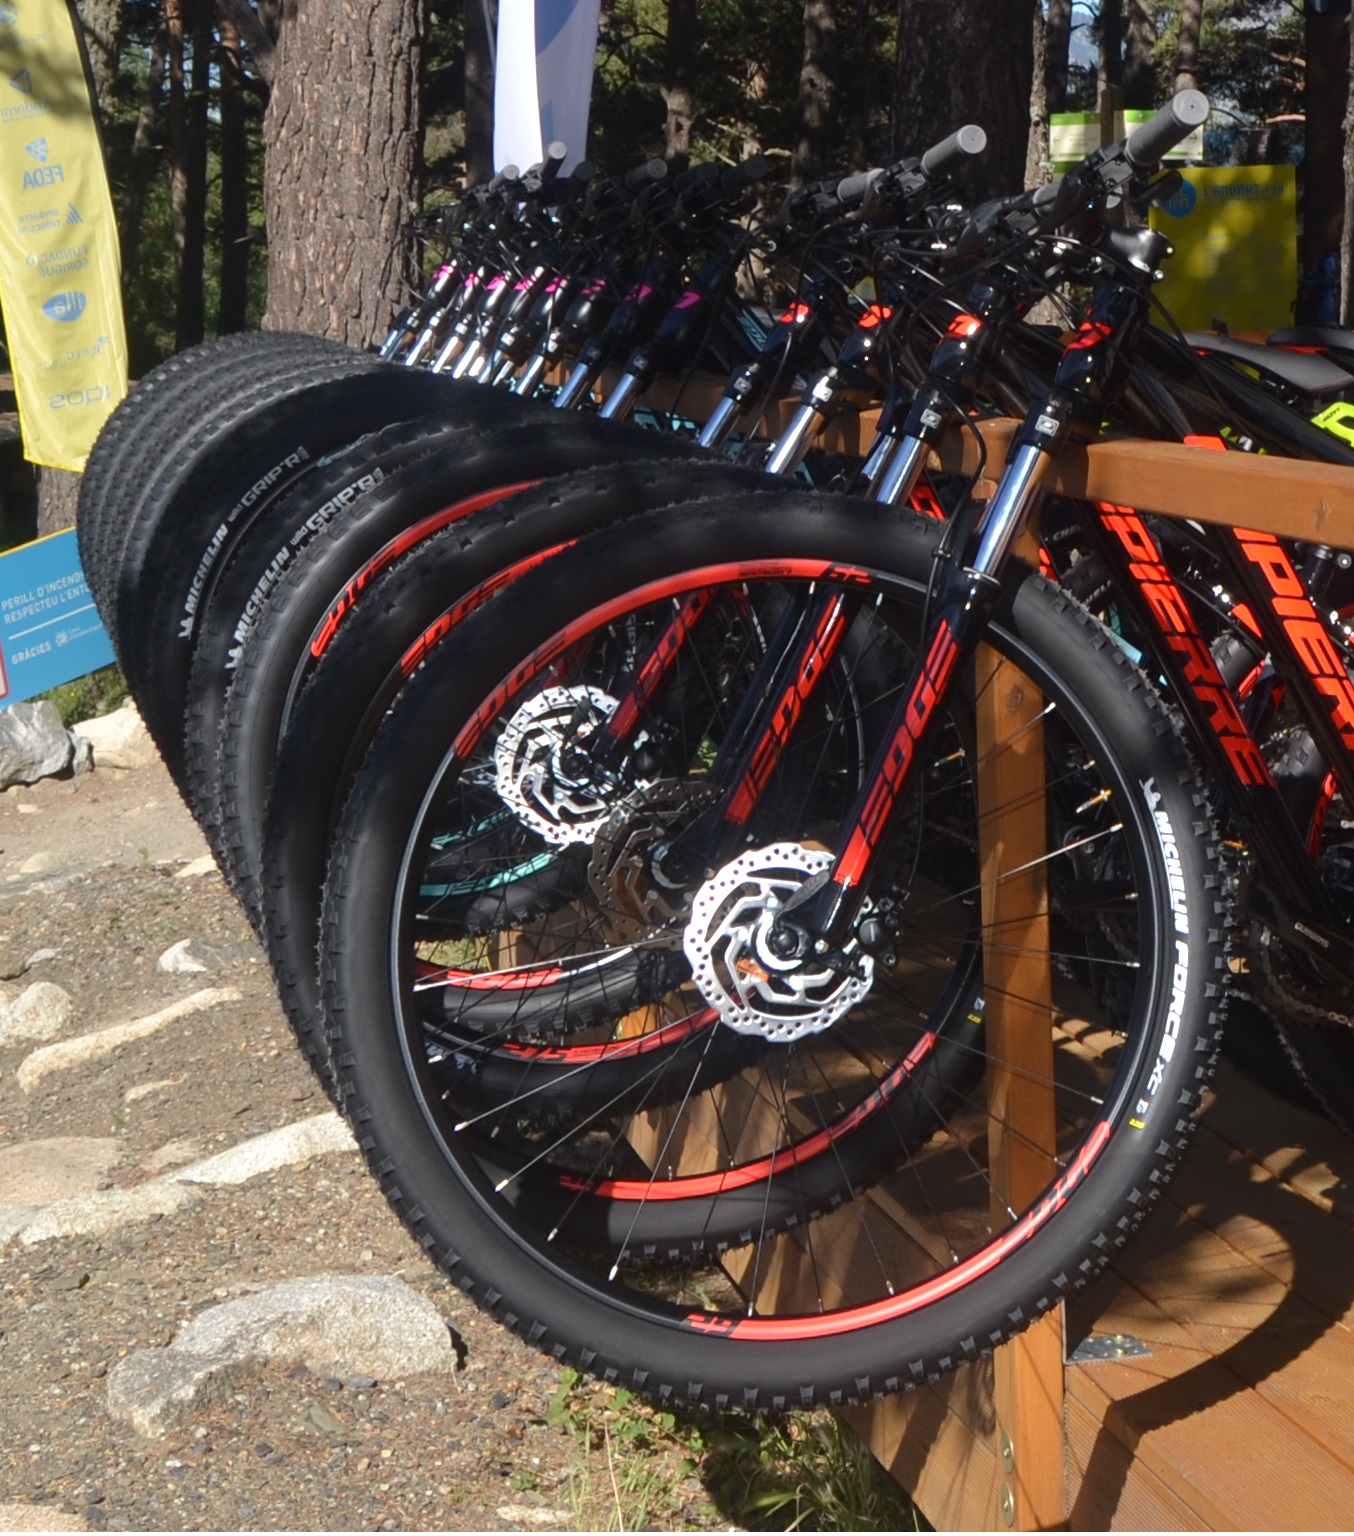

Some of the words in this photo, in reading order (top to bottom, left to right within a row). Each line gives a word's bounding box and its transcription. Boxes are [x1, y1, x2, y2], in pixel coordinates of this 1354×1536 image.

[1, 590, 35, 611] PERILL
[4, 597, 59, 625] RESPECTEU
[184, 523, 229, 615] MICHELIN
[233, 546, 291, 644] MICHELIN
[1100, 501, 1278, 788] PIERRE
[1153, 809, 1189, 934] MICHELIN
[1158, 940, 1189, 1064] FORCE
